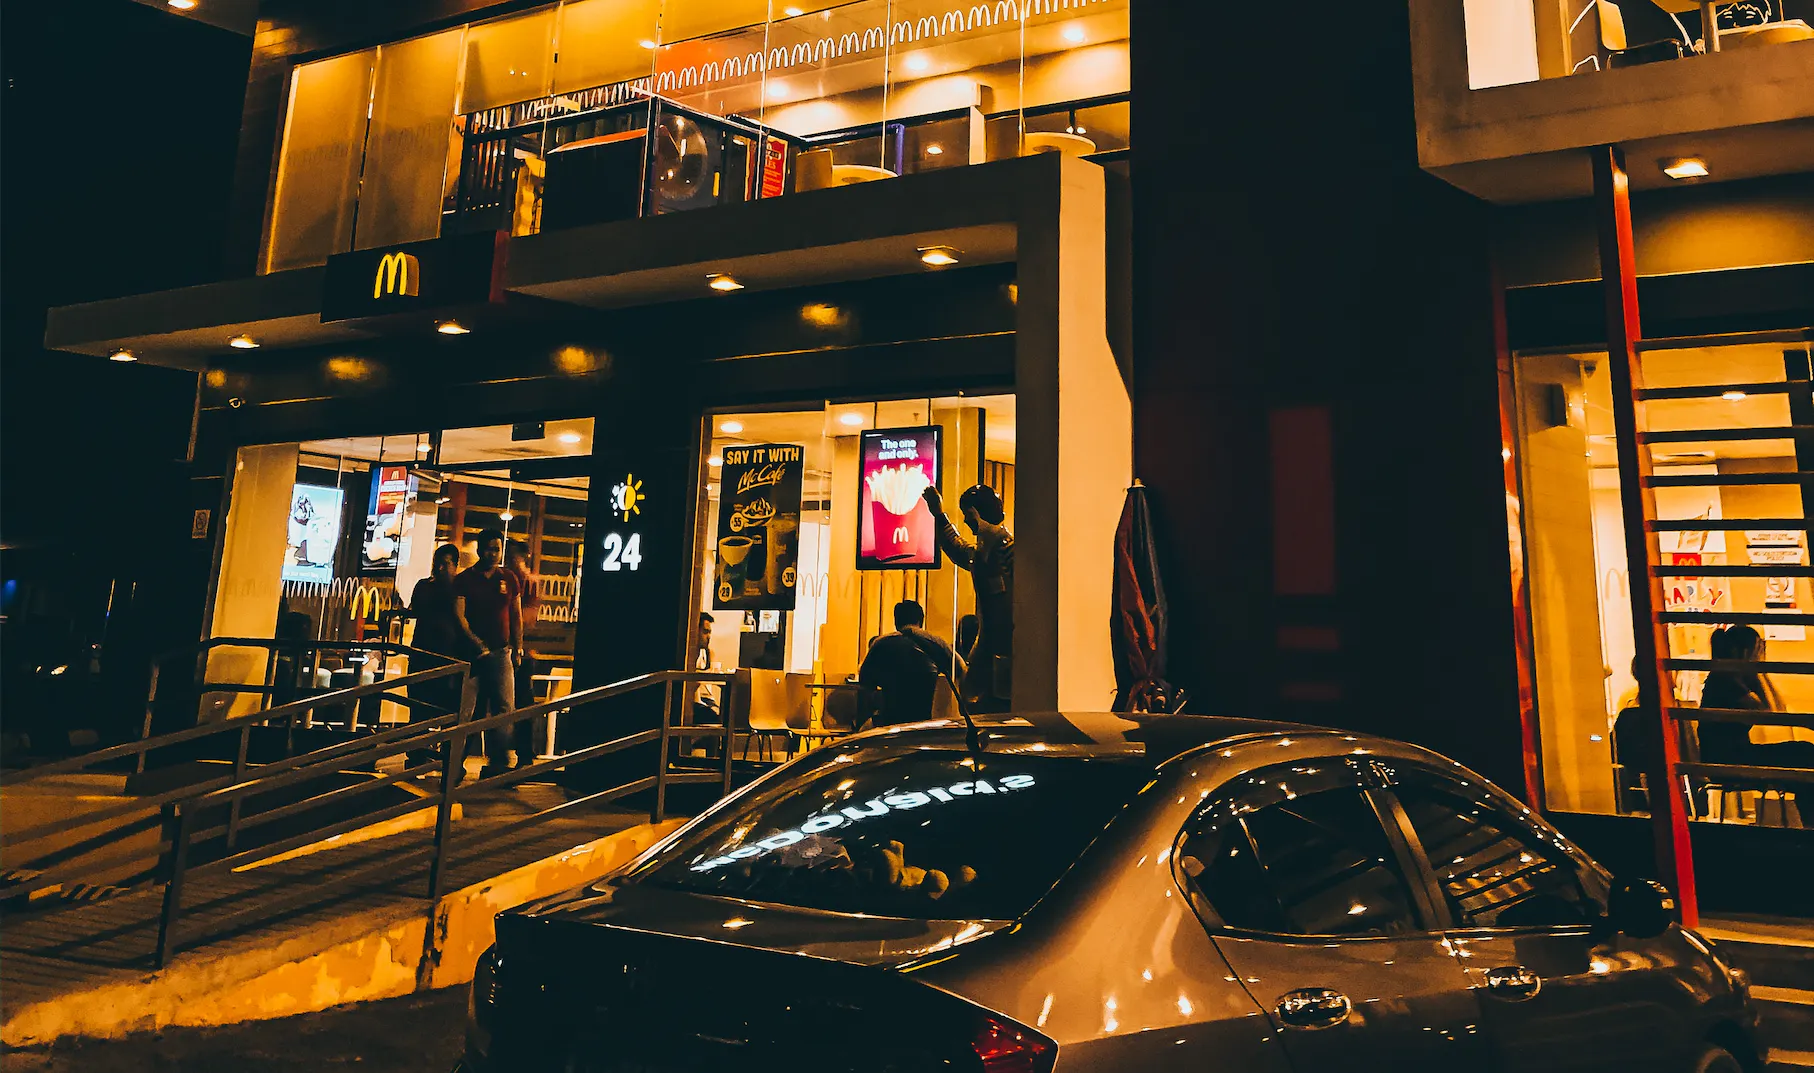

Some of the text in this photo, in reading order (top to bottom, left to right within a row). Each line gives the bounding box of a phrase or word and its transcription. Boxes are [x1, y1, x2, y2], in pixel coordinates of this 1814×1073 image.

[880, 439, 917, 450] The one
[726, 447, 800, 466] SAY IT WITH
[878, 448, 919, 461] and only.
[736, 462, 786, 494] McCafé
[733, 517, 742, 528] 55
[601, 532, 642, 572] 24
